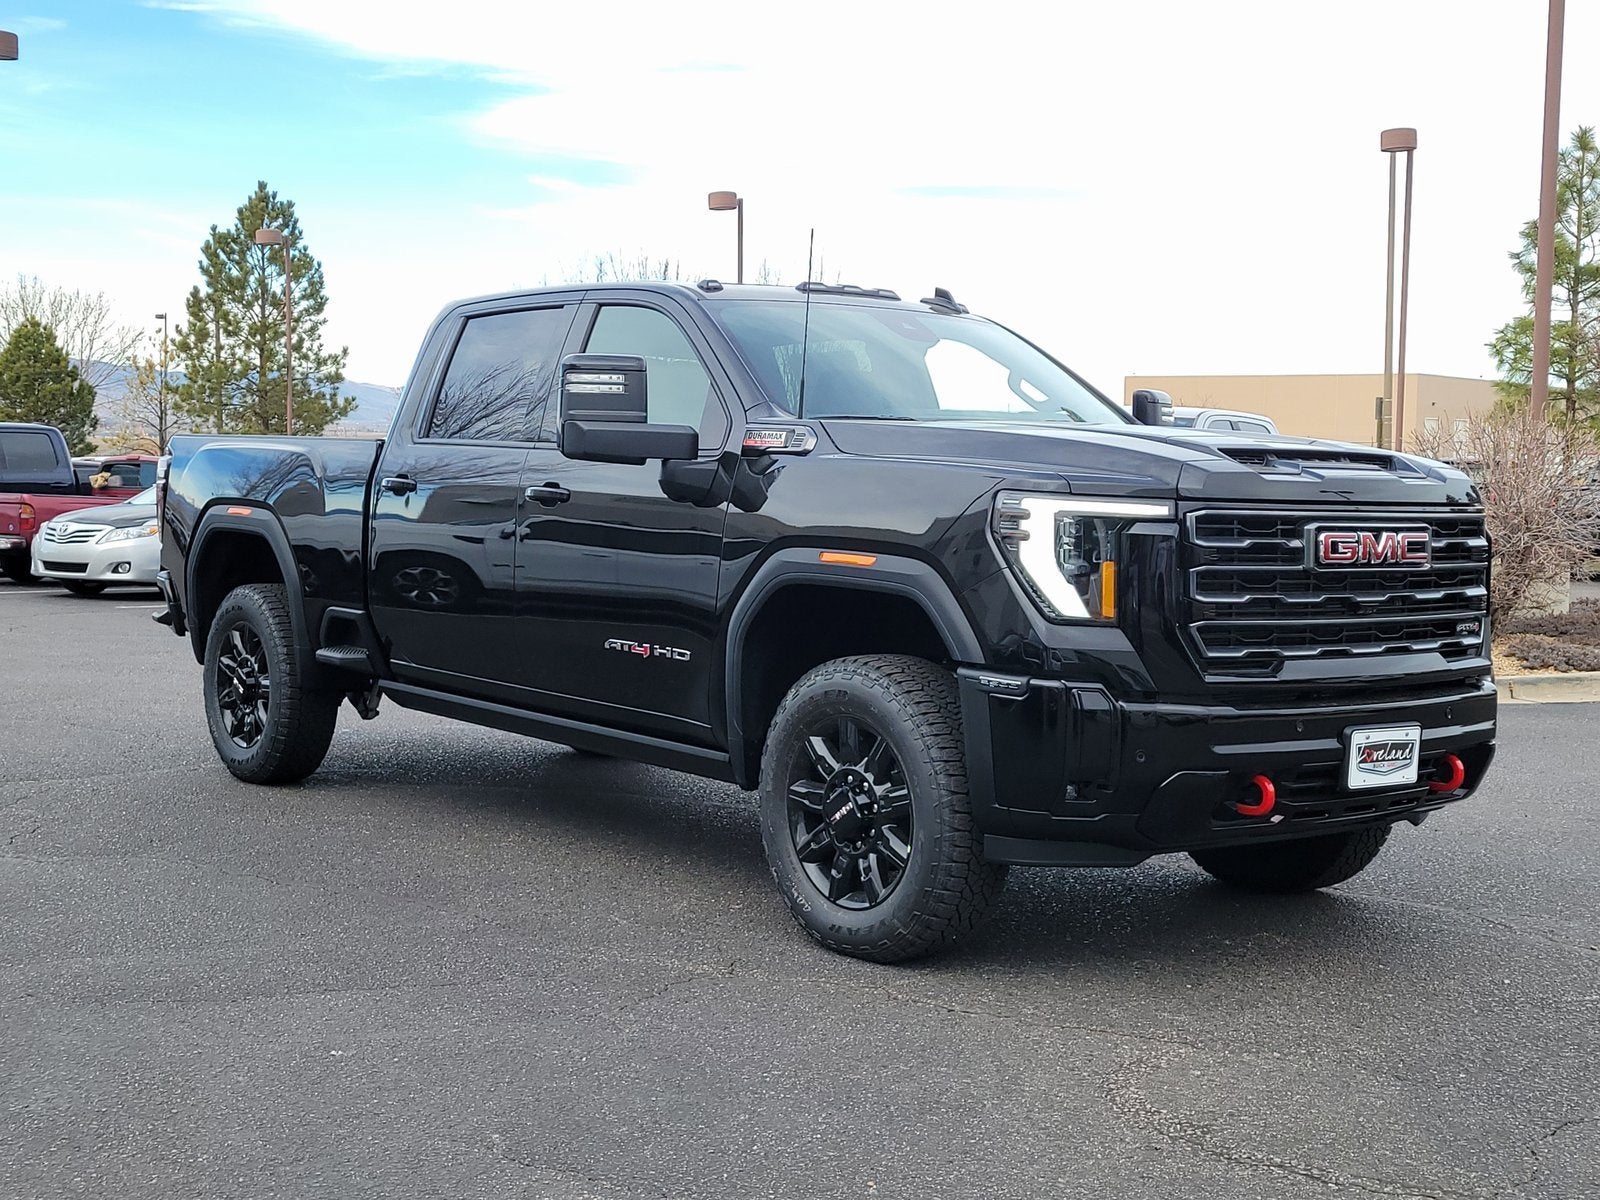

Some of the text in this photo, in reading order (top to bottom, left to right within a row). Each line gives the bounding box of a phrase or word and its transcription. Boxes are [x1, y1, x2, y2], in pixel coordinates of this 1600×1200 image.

[747, 431, 784, 440] DURAMAX
[1319, 531, 1429, 564] GMC
[1357, 741, 1413, 763] Loveland
